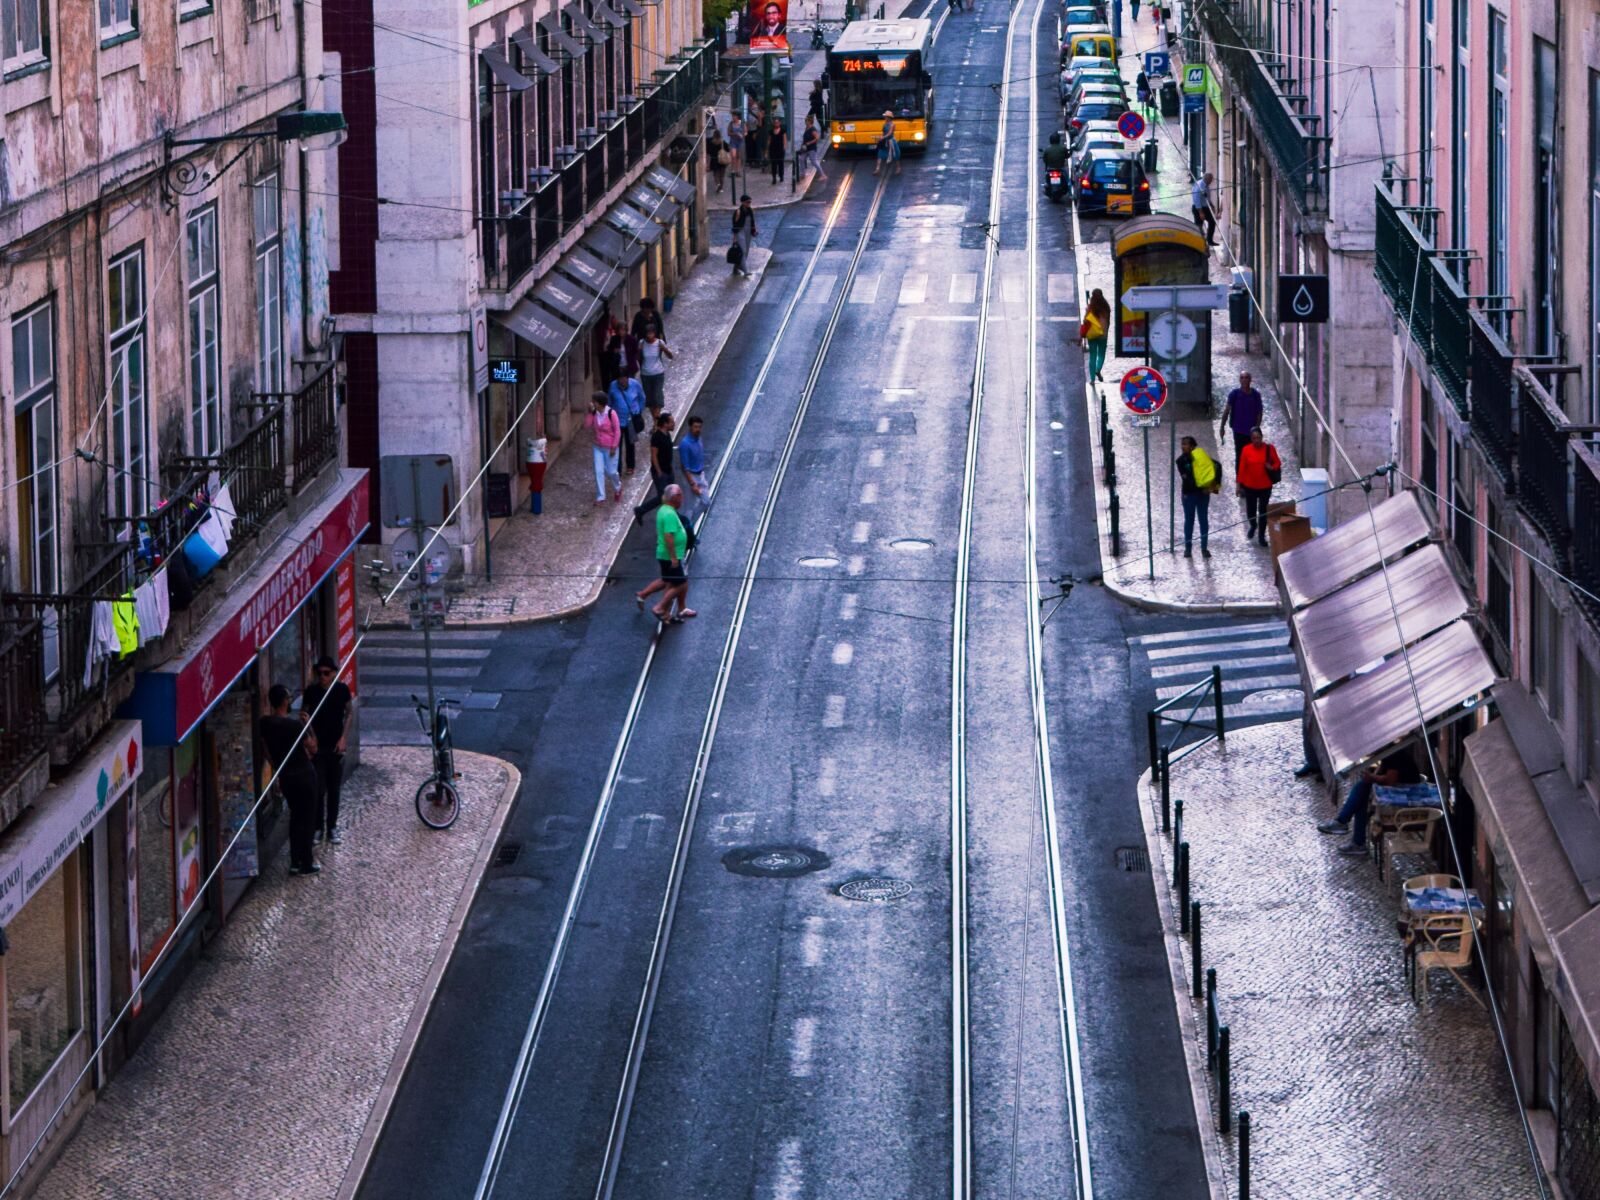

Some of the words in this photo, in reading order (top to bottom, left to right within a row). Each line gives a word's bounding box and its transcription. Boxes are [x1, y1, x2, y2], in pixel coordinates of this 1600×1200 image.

[843, 59, 861, 72] 714
[1150, 56, 1163, 73] P
[1190, 69, 1203, 81] M
[240, 529, 323, 642] MINIMERCADO
[255, 571, 311, 647] FRUTARIA
